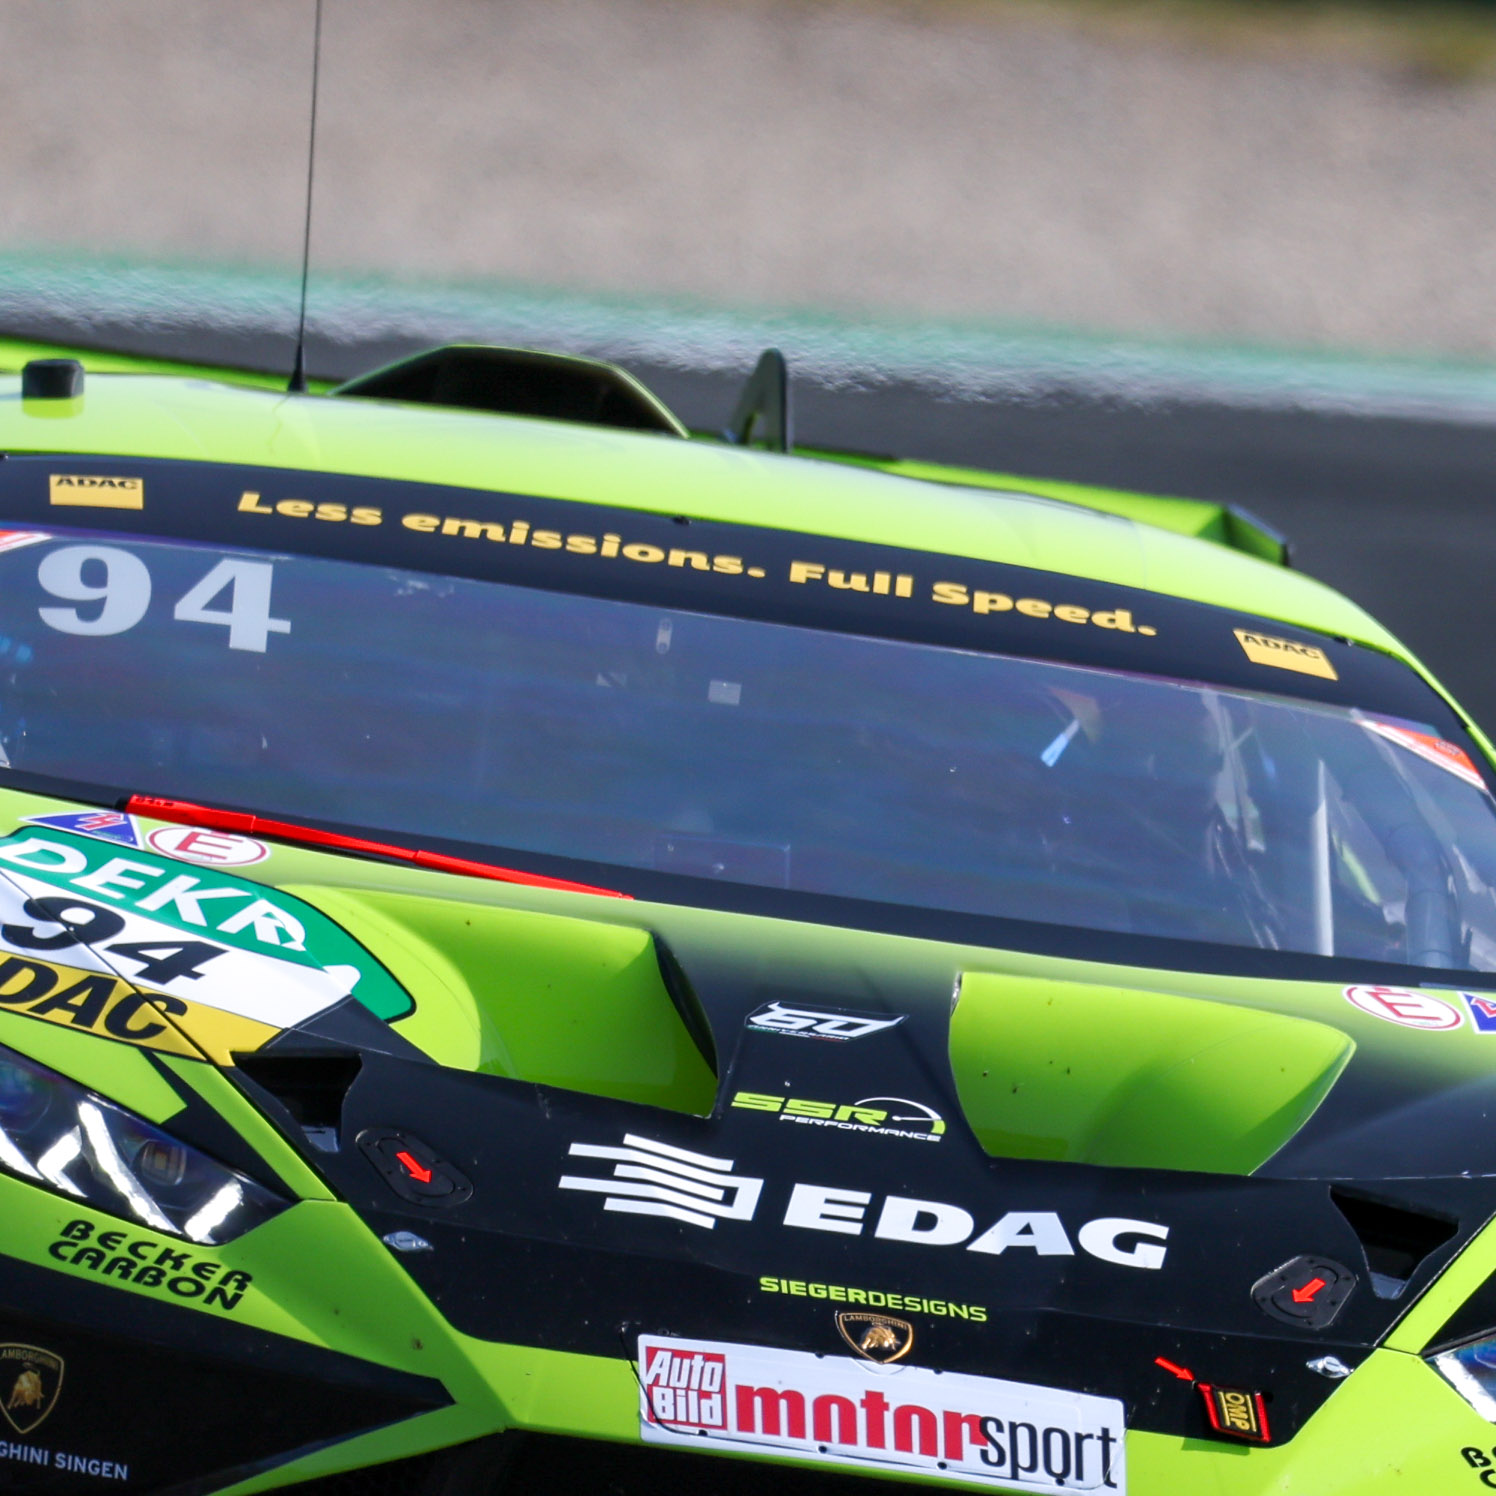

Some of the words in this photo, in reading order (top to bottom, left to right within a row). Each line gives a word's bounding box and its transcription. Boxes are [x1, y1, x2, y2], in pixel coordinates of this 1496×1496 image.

[56, 476, 138, 490] ADAC
[237, 491, 383, 526] Less
[402, 512, 766, 578] emissions.
[789, 560, 914, 598] Full
[932, 581, 1157, 637] Speed.
[37, 544, 292, 653] 94
[1243, 634, 1321, 660] ADAC
[0, 896, 231, 986] 94
[730, 1091, 888, 1126] SSR
[779, 1114, 942, 1142] PERFORMANCE
[782, 1182, 1170, 1271] EDAG
[48, 1240, 245, 1311] CARBON
[60, 1219, 253, 1293] BECKER
[759, 1276, 988, 1322] SIEGERDESIGNS
[646, 1350, 724, 1394] Auto
[653, 1387, 723, 1427] Bild
[1225, 1392, 1251, 1431] OMP
[54, 1451, 129, 1481] SINGEN
